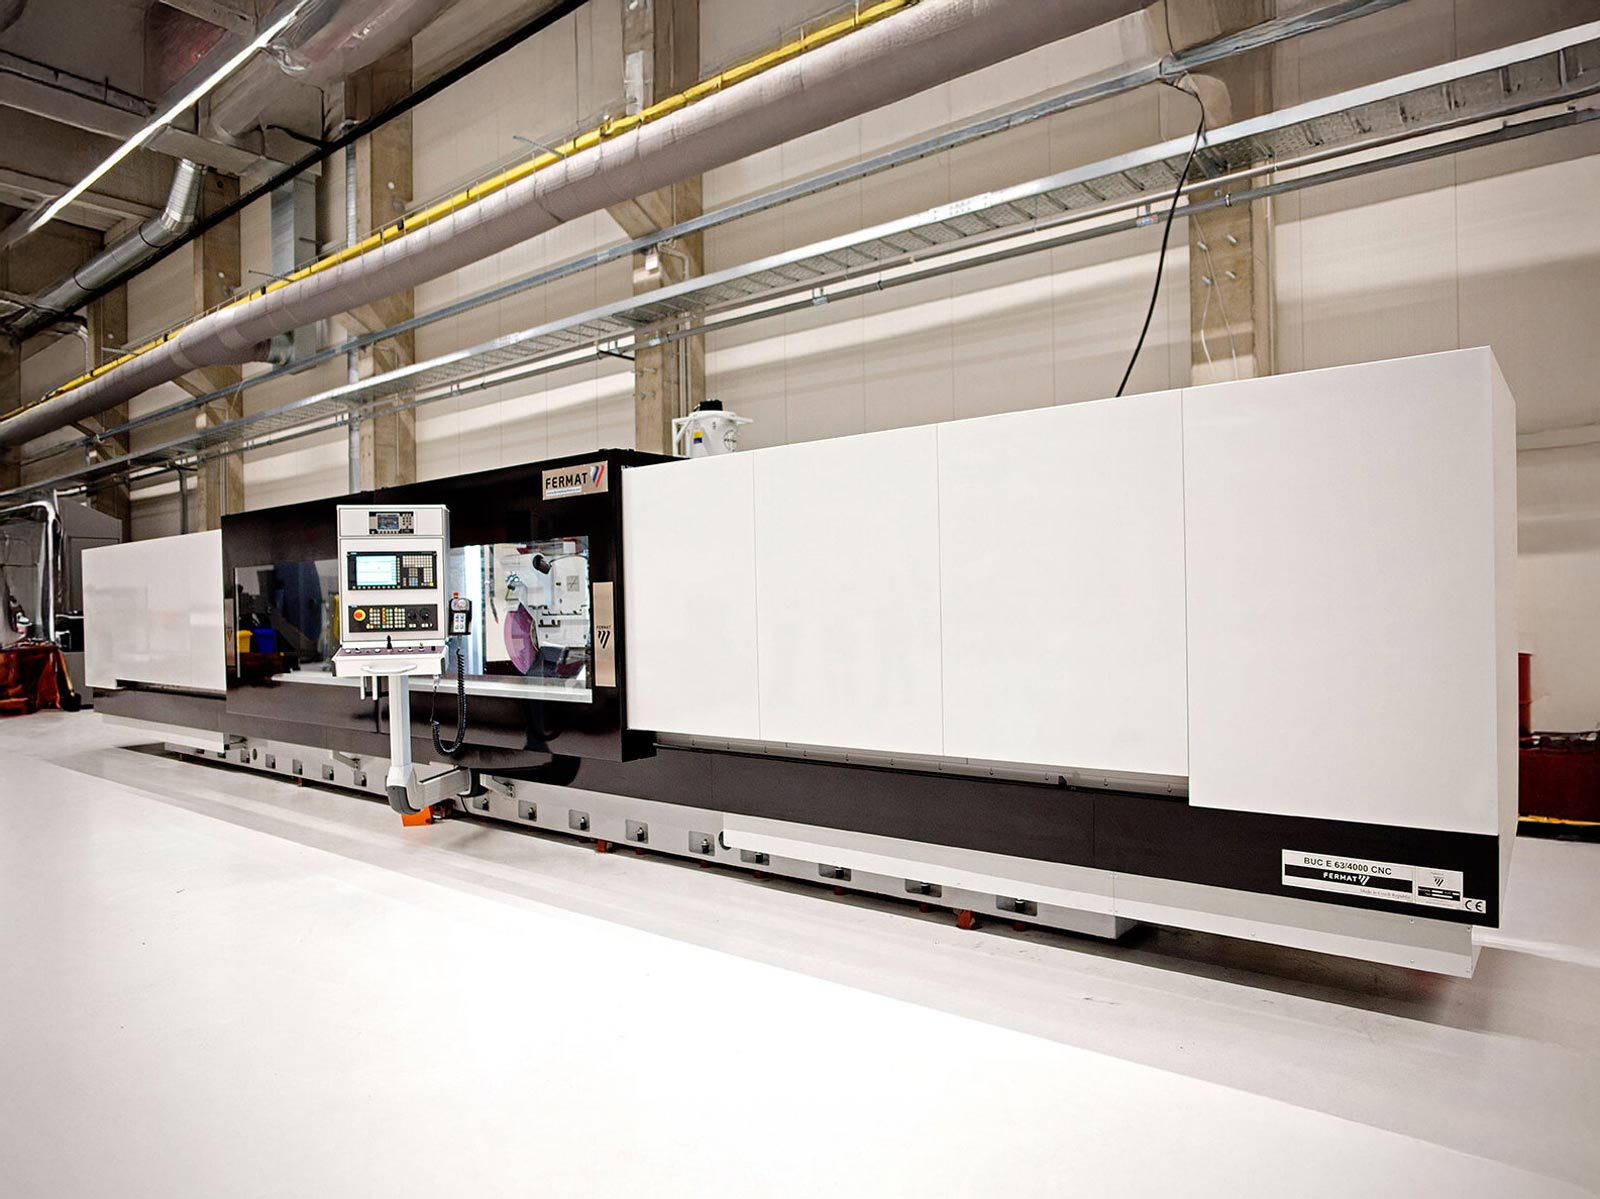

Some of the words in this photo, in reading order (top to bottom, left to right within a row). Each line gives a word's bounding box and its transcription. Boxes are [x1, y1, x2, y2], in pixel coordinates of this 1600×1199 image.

[545, 472, 588, 490] FERMAT
[1303, 857, 1323, 866] BUC
[1334, 861, 1369, 873] 63/4000
[1371, 866, 1392, 876] CNC
[1323, 871, 1358, 883] FERMAT
